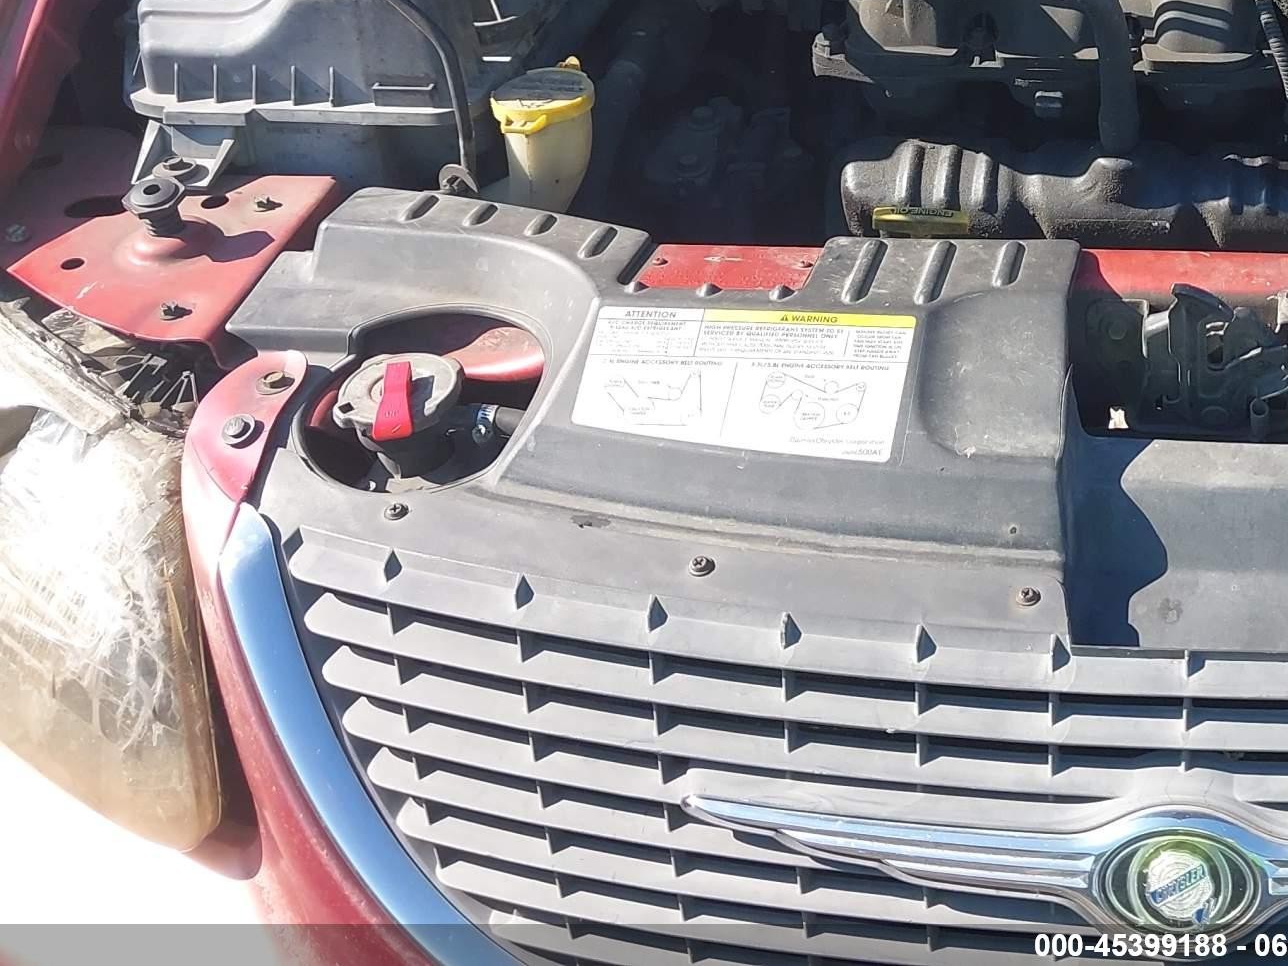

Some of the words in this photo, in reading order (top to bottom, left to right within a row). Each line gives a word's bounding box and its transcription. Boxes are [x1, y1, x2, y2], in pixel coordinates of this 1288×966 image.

[909, 207, 954, 217] ENGINE
[624, 310, 677, 319] ATTENTION
[791, 315, 839, 323] WARNING
